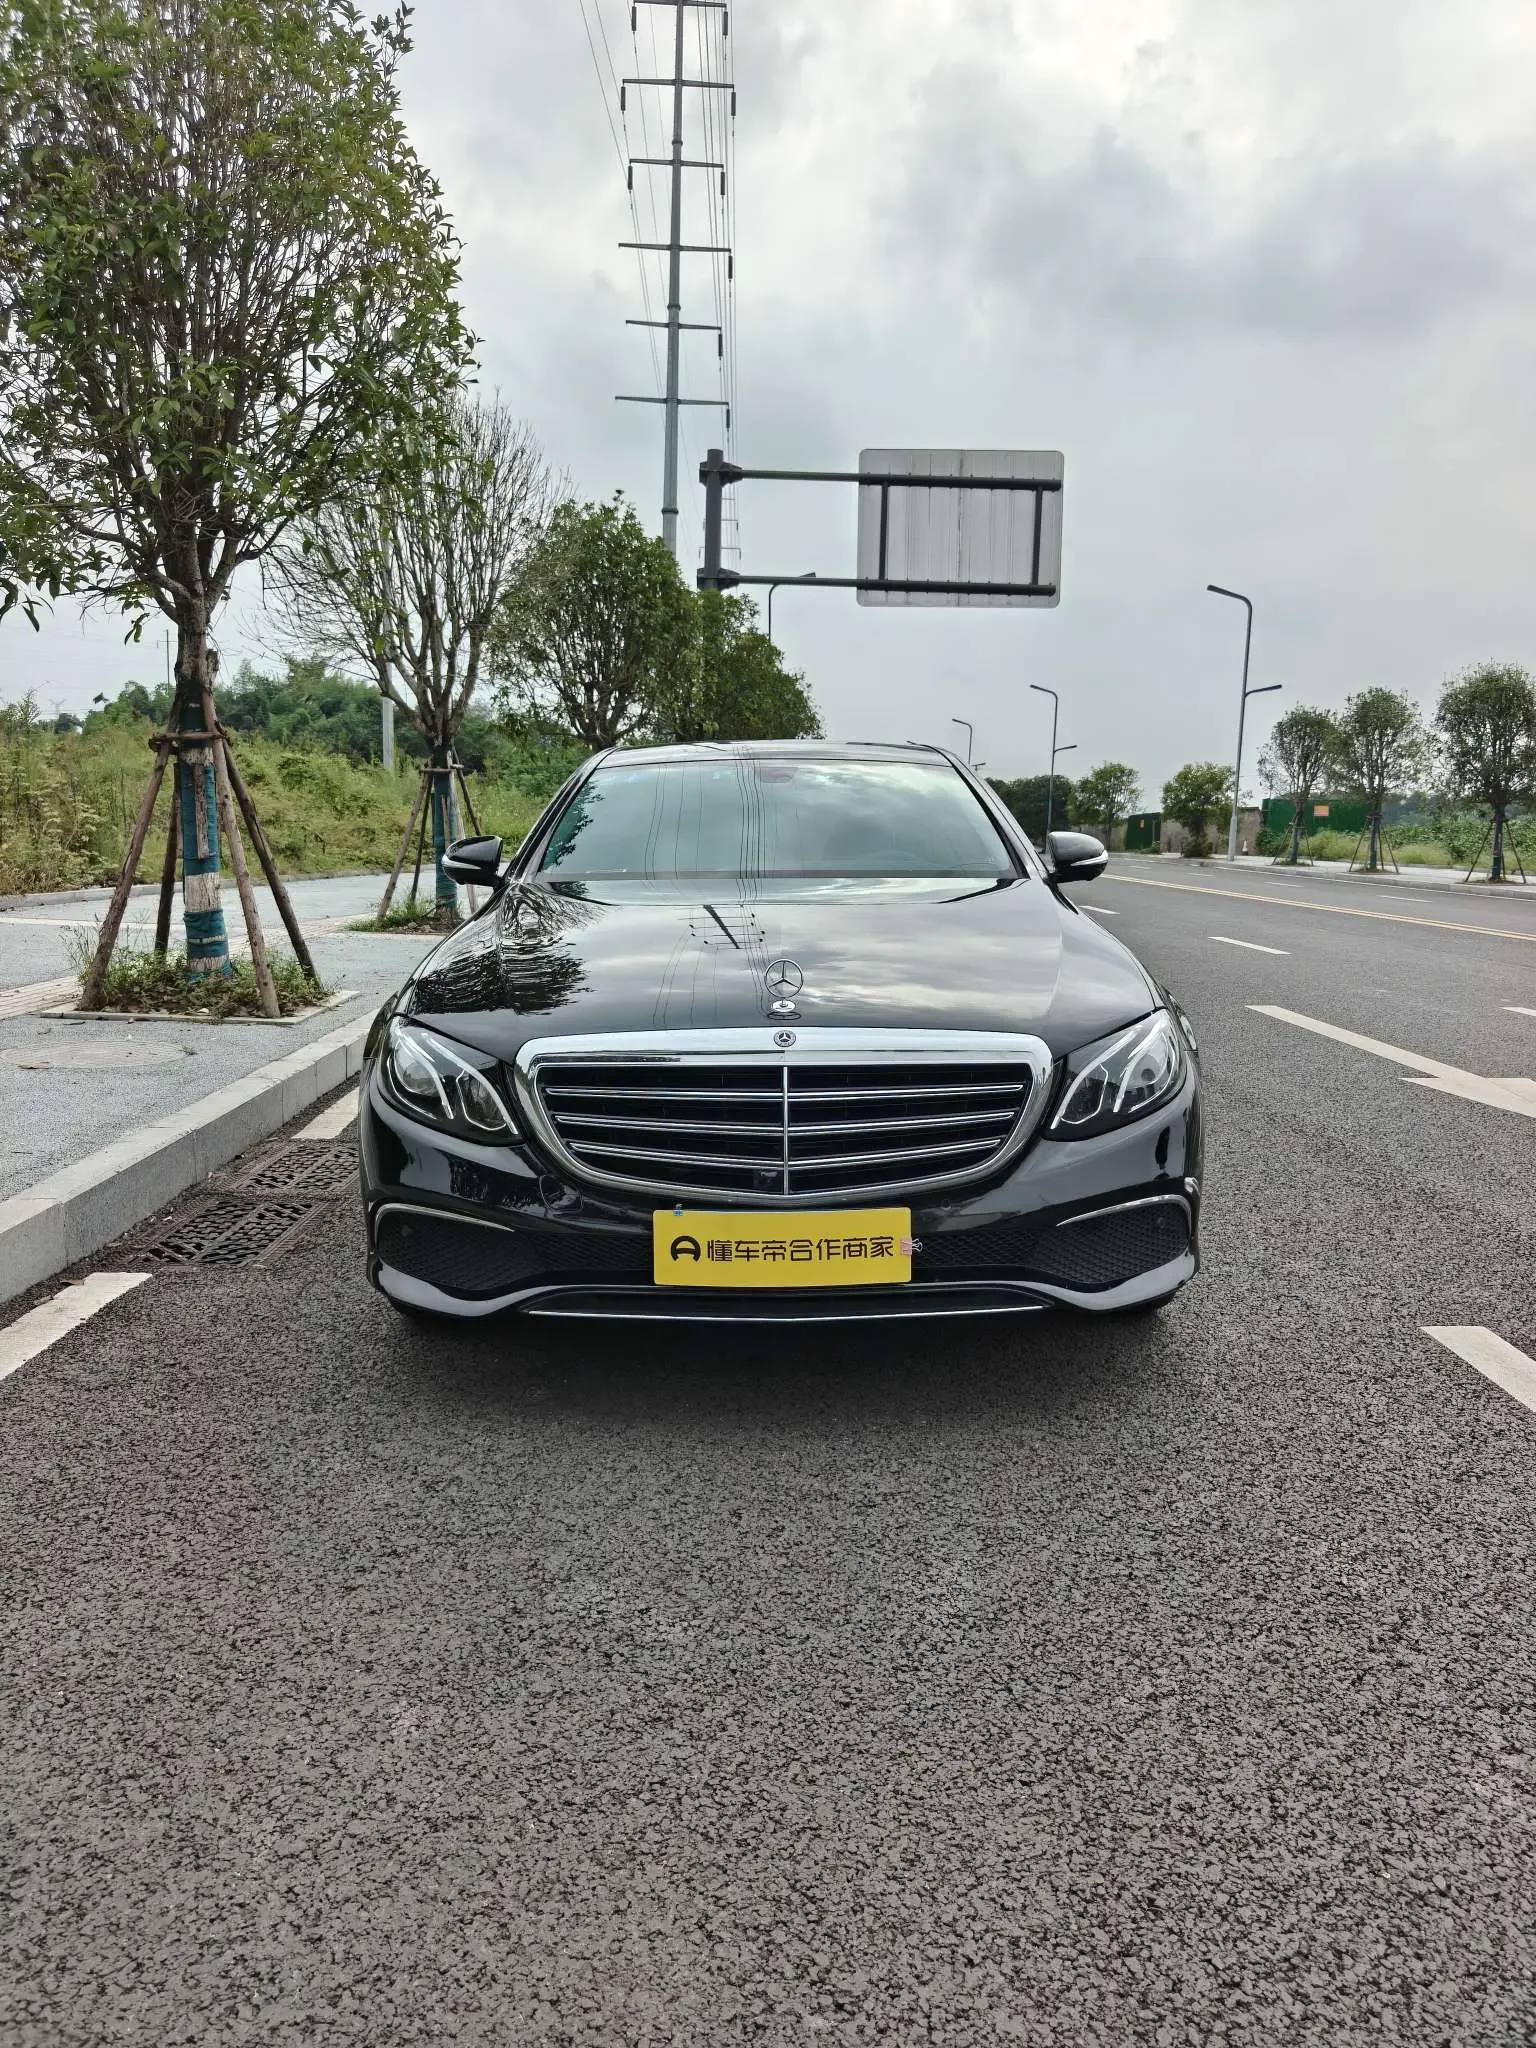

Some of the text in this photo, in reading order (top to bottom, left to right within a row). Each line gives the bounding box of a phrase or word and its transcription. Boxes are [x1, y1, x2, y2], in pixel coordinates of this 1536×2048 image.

[706, 1236, 894, 1262] 懂车帝合作商家
